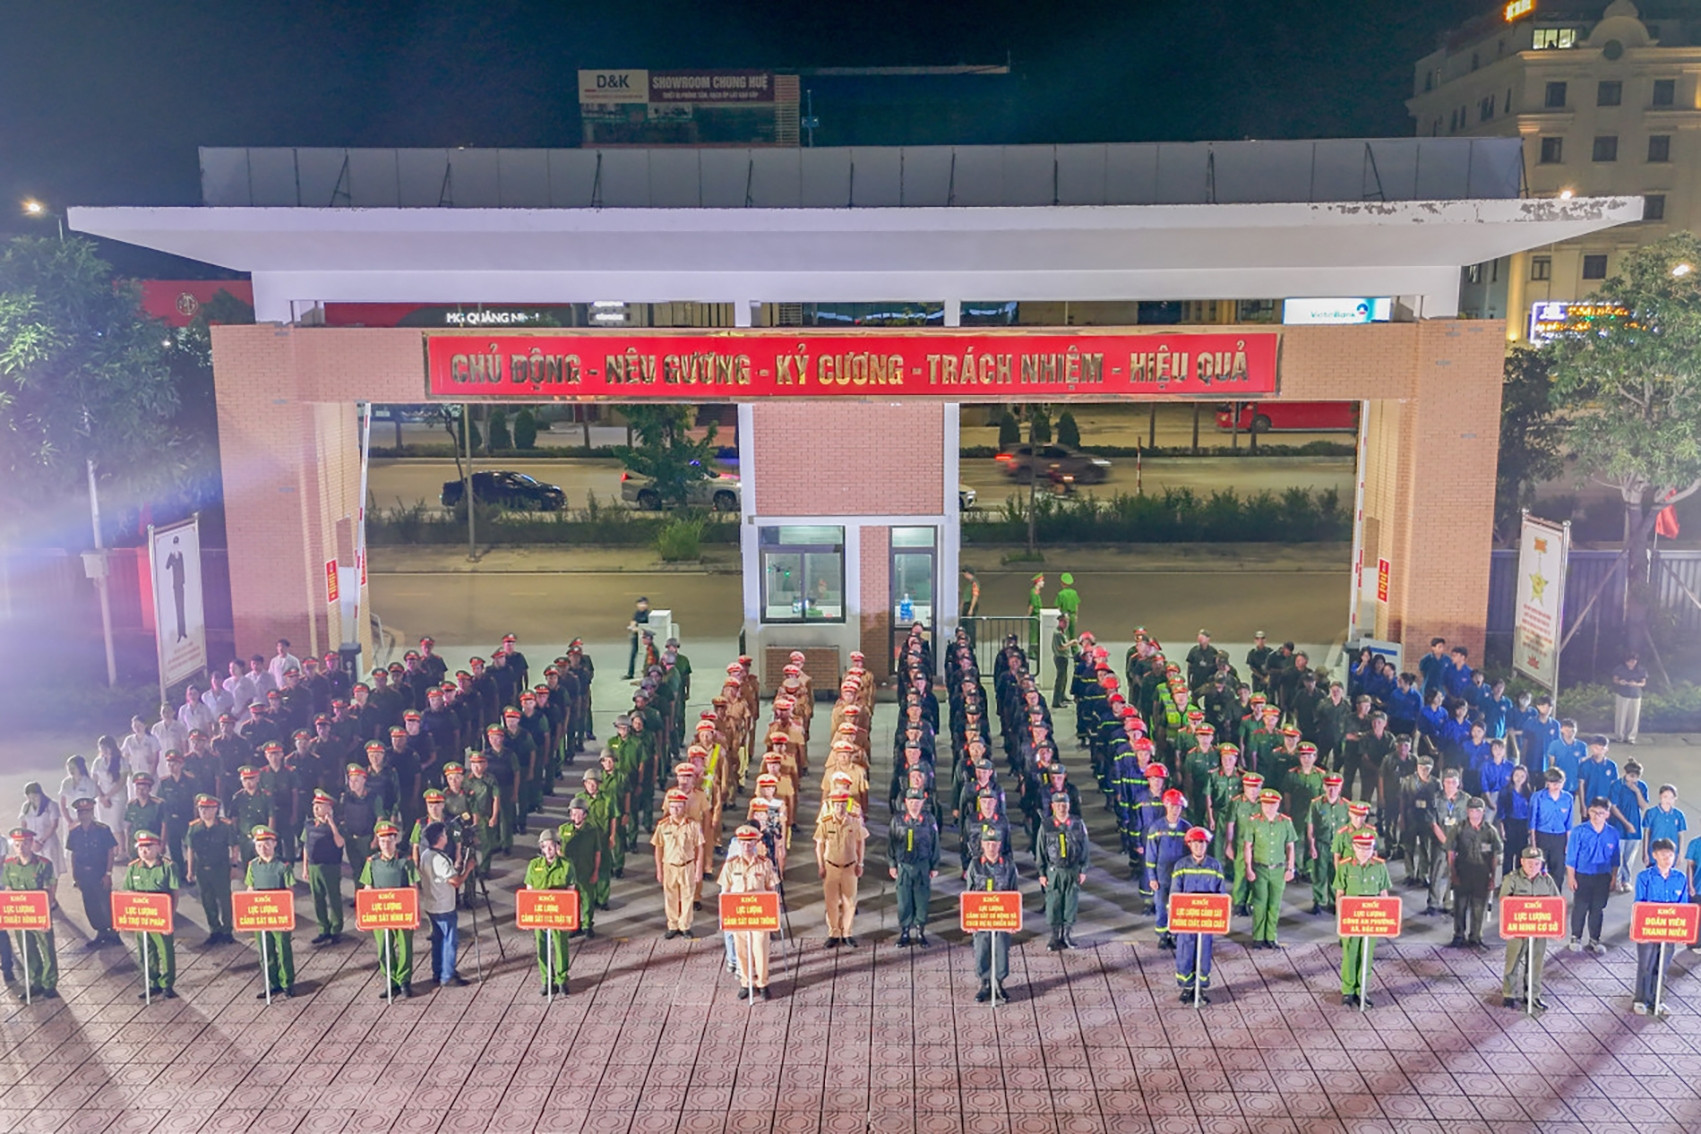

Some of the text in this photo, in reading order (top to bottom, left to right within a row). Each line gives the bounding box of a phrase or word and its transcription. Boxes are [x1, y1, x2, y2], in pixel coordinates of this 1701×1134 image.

[597, 74, 630, 88] D&K
[652, 76, 711, 89] SHOWROOM
[713, 76, 746, 89] CHUNG
[451, 344, 501, 383] CHỦ
[509, 348, 581, 390] ĐỘNG
[605, 347, 657, 385] NÊU
[664, 350, 751, 386] GƯƠNG
[776, 343, 810, 385] KỶ
[818, 350, 904, 386] CƯƠNG
[926, 346, 1012, 385] TRÁCH
[1020, 345, 1105, 390] NHIỆM
[1130, 344, 1189, 390] HIỆU
[1197, 340, 1248, 386] QUẢ
